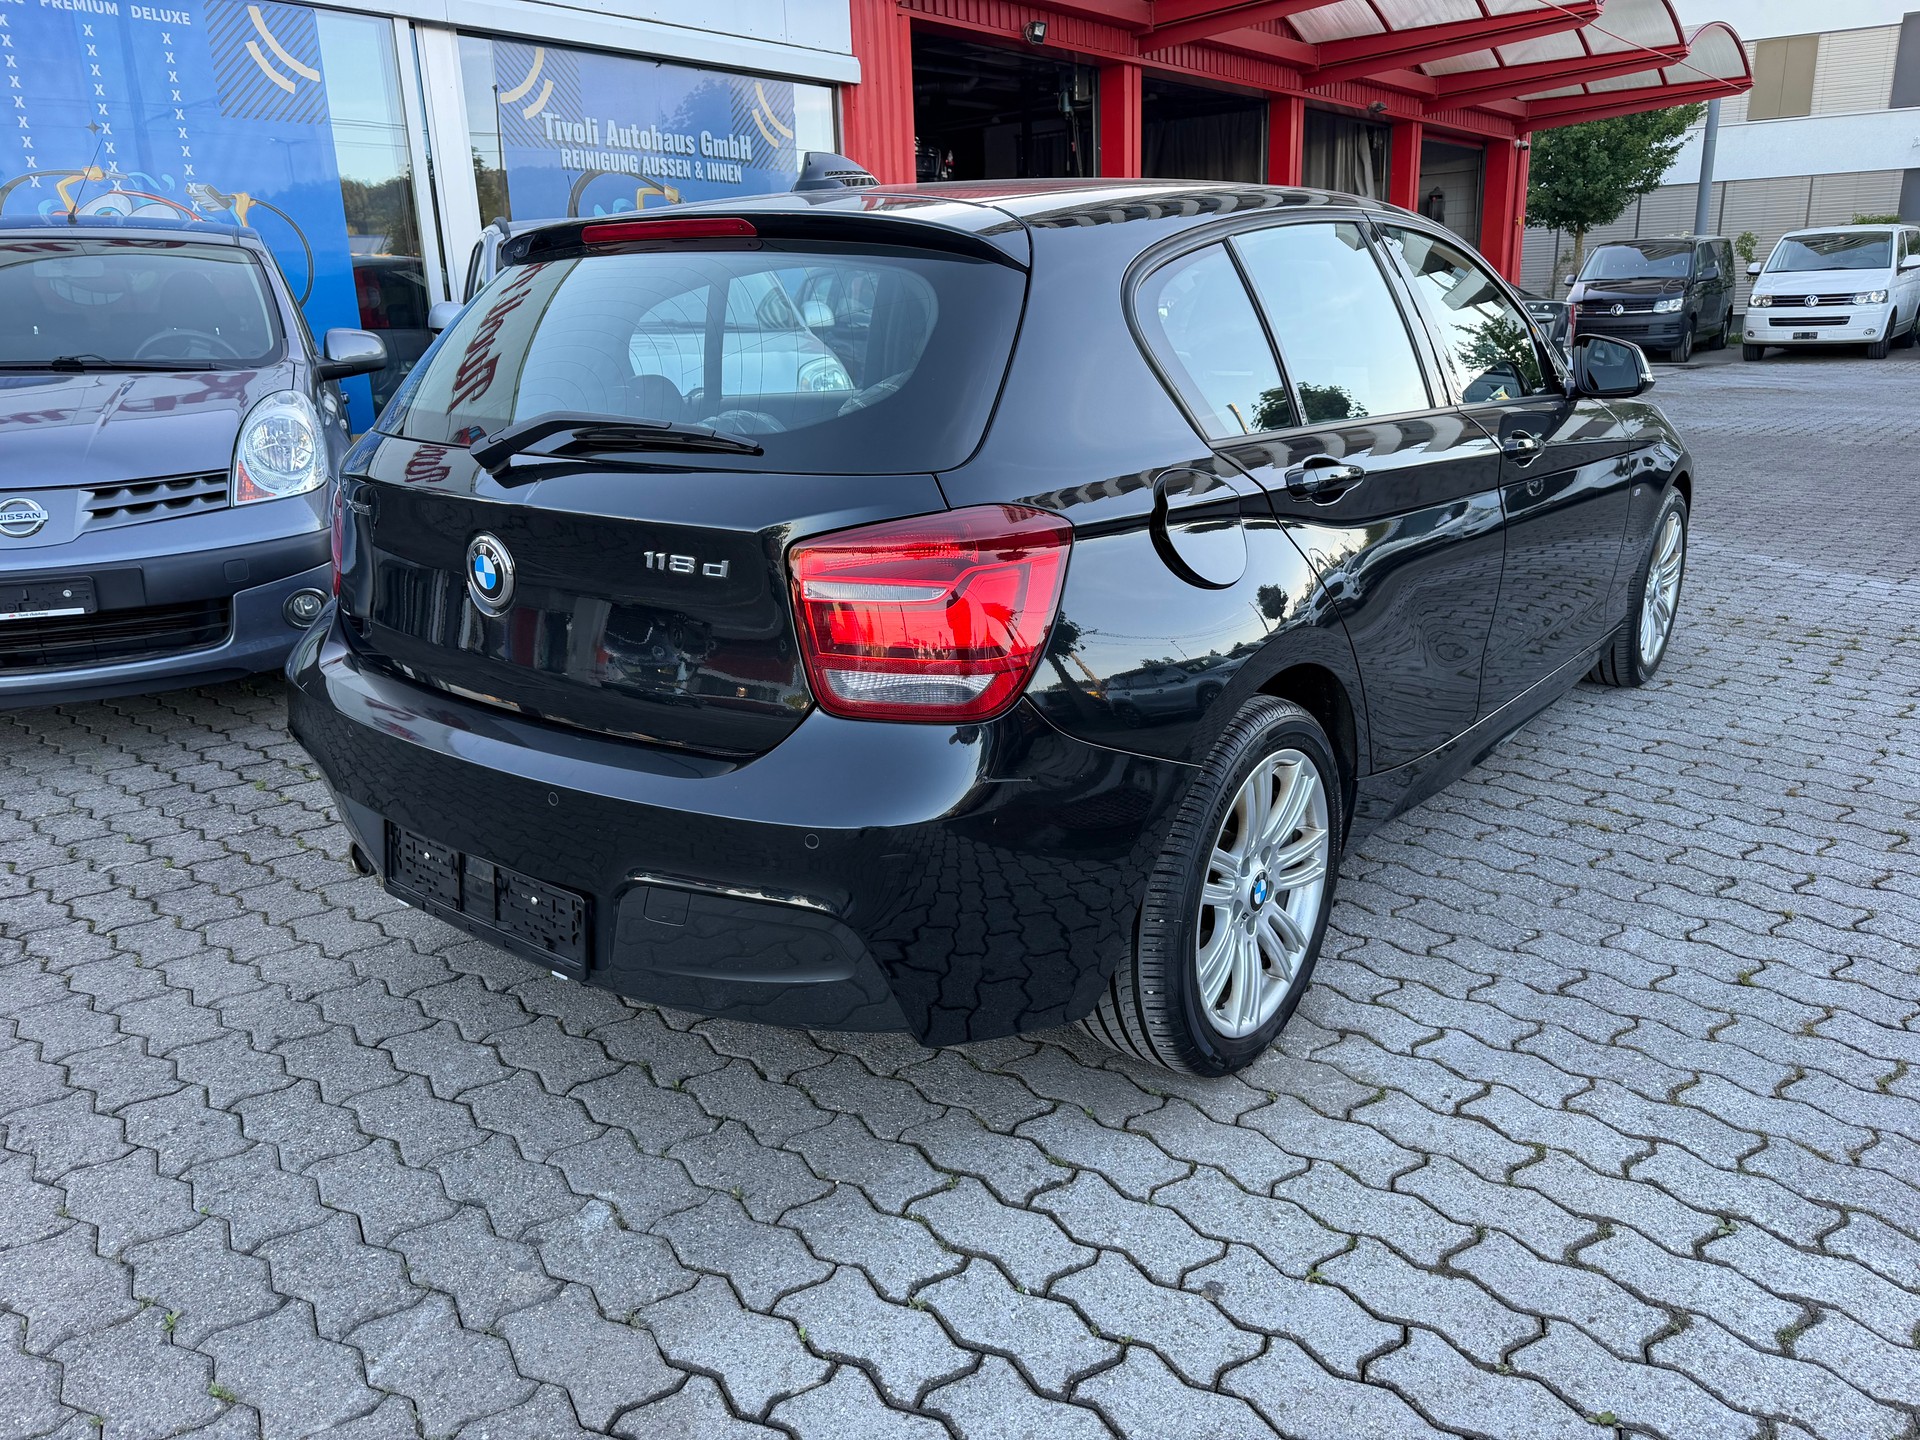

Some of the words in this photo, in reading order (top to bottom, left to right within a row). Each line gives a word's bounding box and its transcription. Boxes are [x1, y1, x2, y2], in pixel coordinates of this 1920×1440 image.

[130, 5, 191, 25] DELUXE
[541, 111, 599, 145] Tivoli
[606, 119, 695, 155] Autohaus
[700, 130, 753, 161] GmbH
[561, 148, 638, 175] REINIGUNG
[642, 156, 692, 180] AUSSEN
[694, 161, 704, 179] &
[706, 162, 743, 184] INNEN
